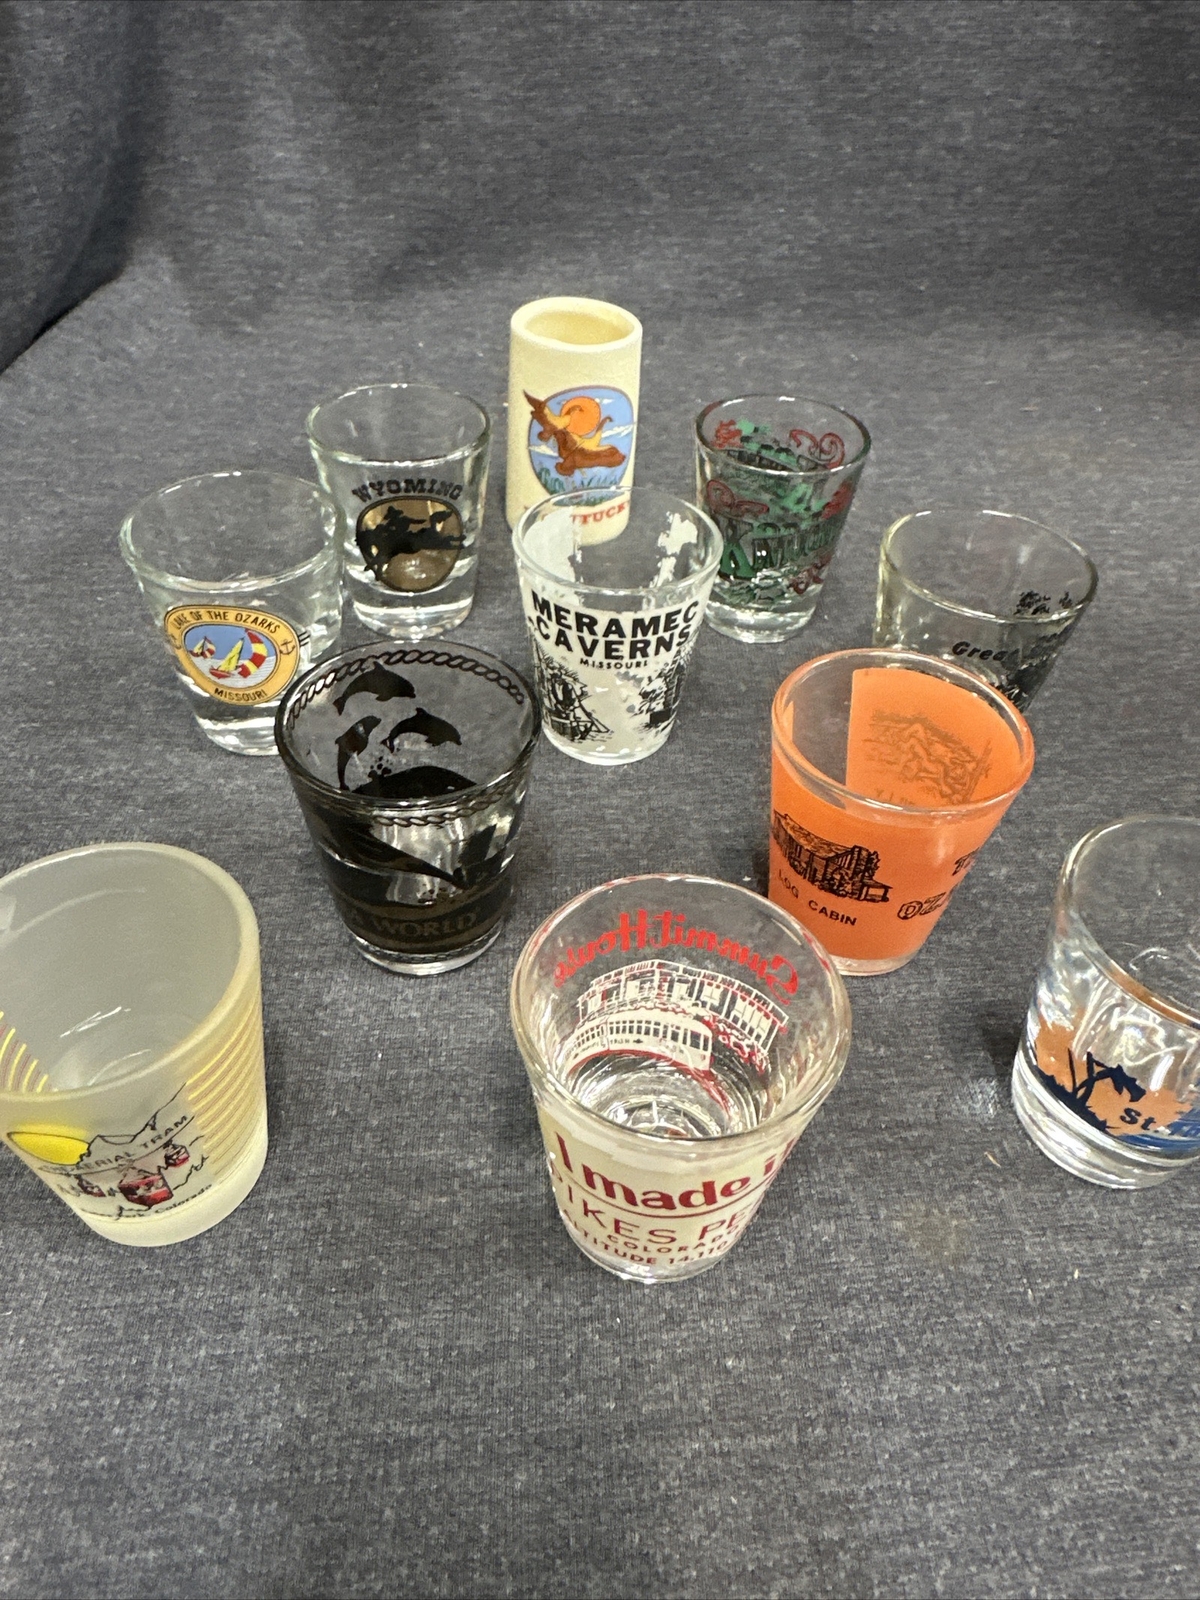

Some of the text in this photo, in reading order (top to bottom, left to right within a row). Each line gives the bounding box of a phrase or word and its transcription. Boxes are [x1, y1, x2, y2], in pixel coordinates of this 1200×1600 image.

[352, 478, 463, 502] WYOMING
[171, 610, 280, 634] LAKE OF THE OZARKS
[531, 589, 699, 638] MERAMEC
[536, 616, 692, 660] CAVERNS
[580, 658, 648, 670] MISSOURI
[214, 687, 267, 702] MISSOURI
[779, 869, 857, 926] LOG CABIN
[373, 912, 477, 937] WORLD
[141, 1115, 188, 1149] TRAM
[556, 1132, 573, 1173] I
[582, 1163, 750, 1211] made
[155, 1183, 212, 1214] Colorado
[562, 1208, 657, 1265] ALTITUDE
[607, 1223, 740, 1253] COLORADO
